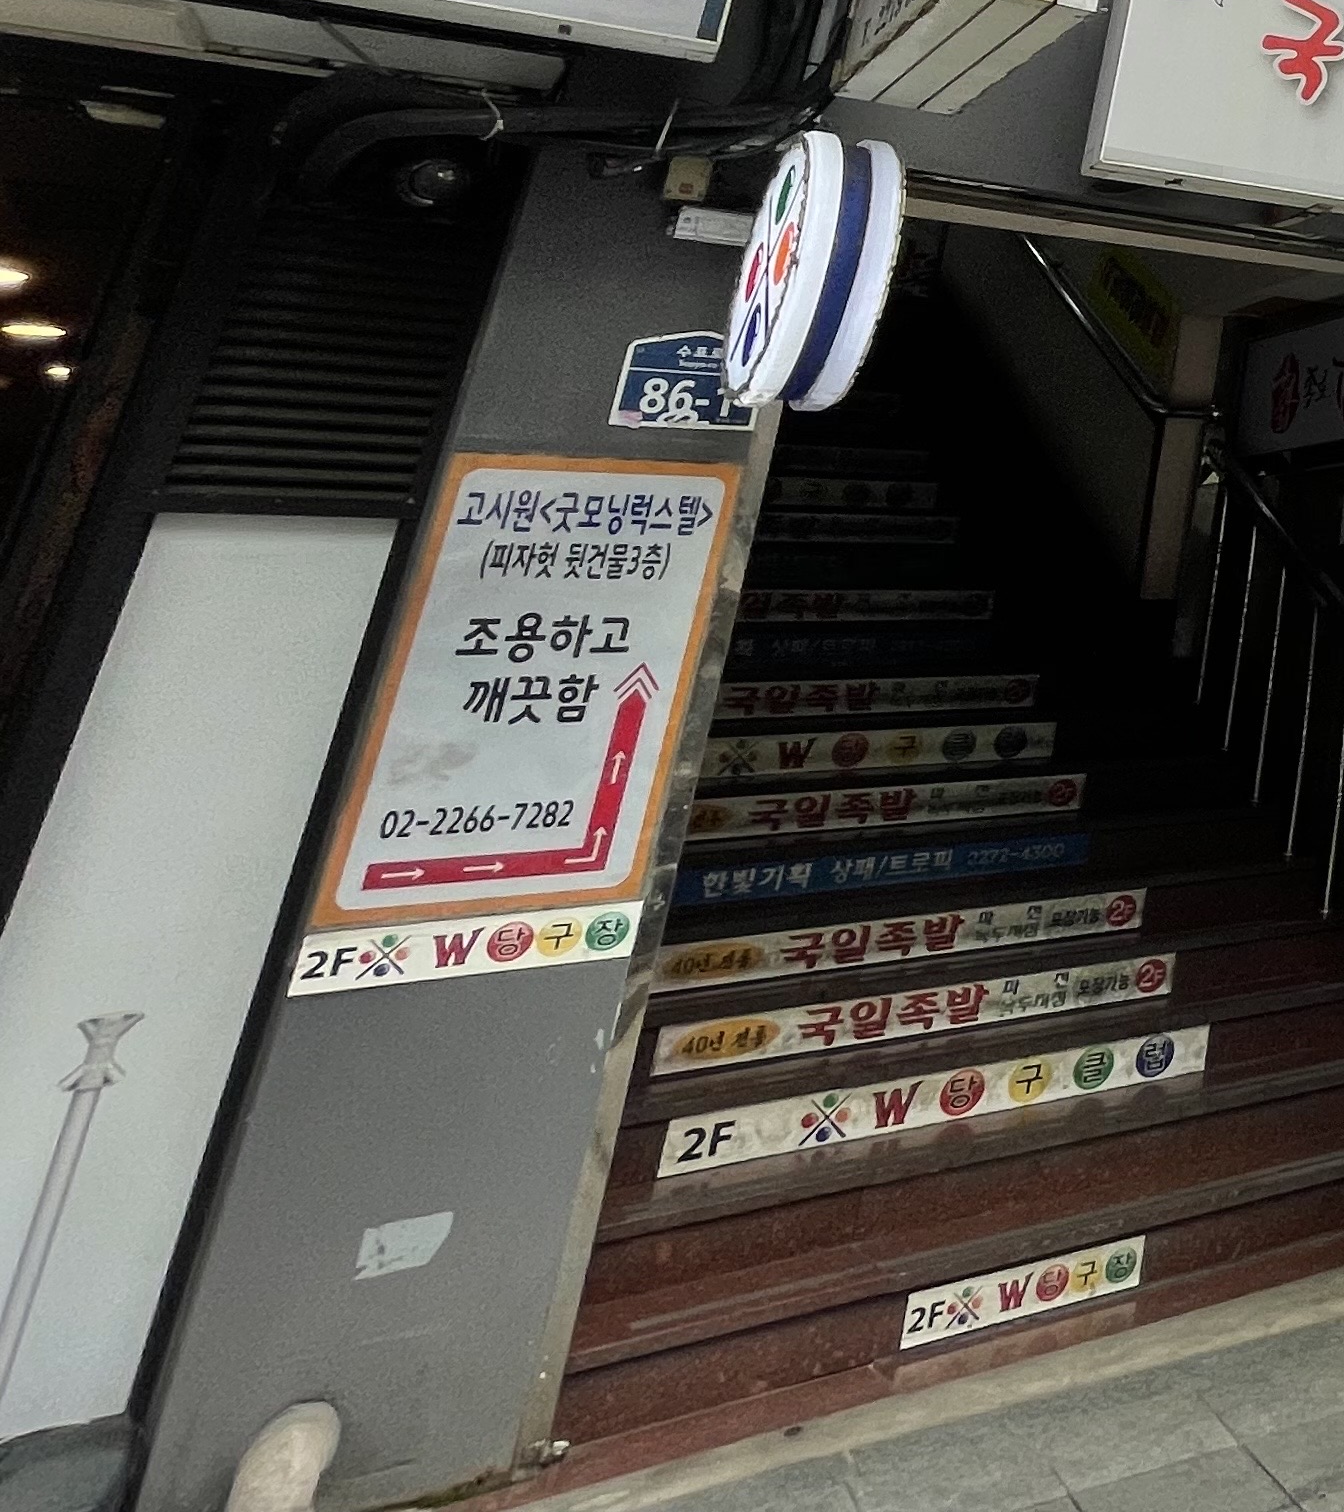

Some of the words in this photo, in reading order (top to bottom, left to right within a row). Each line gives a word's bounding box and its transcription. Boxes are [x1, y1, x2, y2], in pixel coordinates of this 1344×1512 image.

[479, 540, 560, 581] (피자헛
[563, 543, 671, 581] 뒷건물3층)
[455, 612, 631, 664] 조용하고
[462, 676, 600, 727] 깨끗함
[379, 799, 575, 840] 02-2266-7282
[747, 787, 919, 832] 국일족발
[701, 862, 814, 900] 한빛기획
[829, 848, 954, 885] 상패/트로피
[300, 945, 359, 981] 2F
[433, 926, 487, 970] W
[495, 919, 628, 960] 당구장
[779, 912, 967, 970] 국일족발
[797, 982, 991, 1047] 국일족발
[683, 1120, 738, 1163] 2F
[872, 1081, 923, 1129] W
[946, 1037, 1171, 1113] 당구클럽
[906, 1299, 946, 1335] 2F
[998, 1271, 1034, 1314] W
[1038, 1248, 1134, 1300] 당구장
